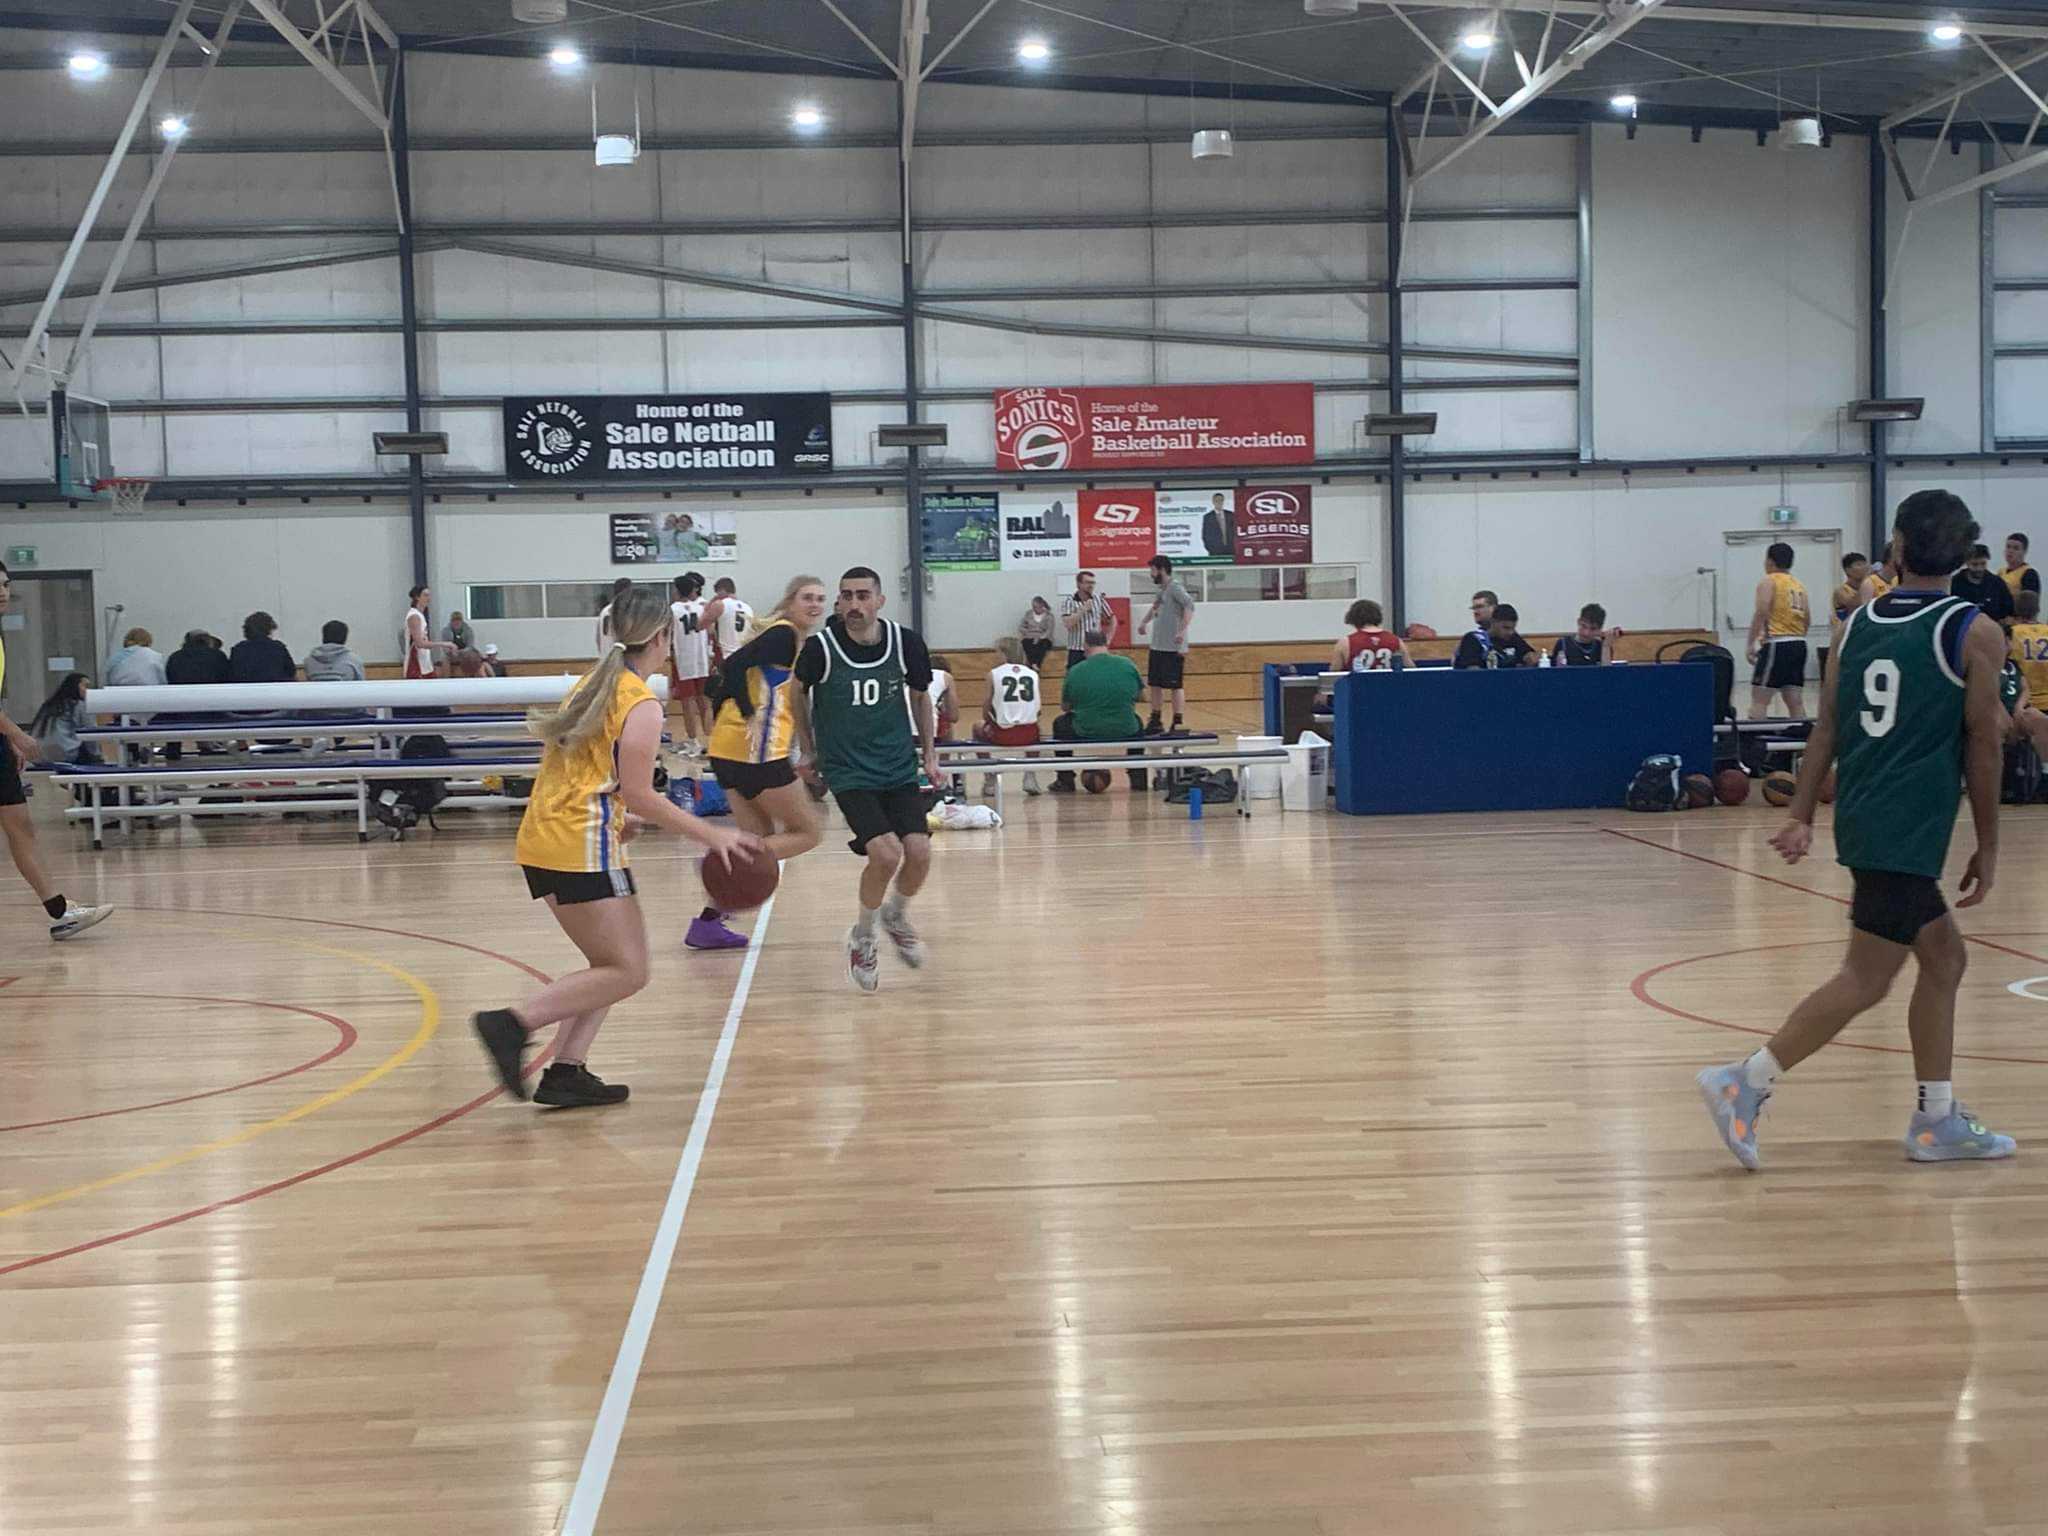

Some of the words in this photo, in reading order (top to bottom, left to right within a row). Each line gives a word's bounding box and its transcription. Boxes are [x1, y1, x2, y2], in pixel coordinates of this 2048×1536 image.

[636, 404, 688, 419] Home
[691, 403, 710, 418] of
[713, 402, 744, 417] the
[1091, 402, 1126, 413] Home
[1127, 402, 1140, 413] of
[1140, 401, 1159, 412] the
[516, 410, 538, 440] SALE
[536, 401, 587, 430] NETBALL
[998, 399, 1077, 442] SONICS
[1092, 416, 1132, 432] Sale
[1134, 415, 1219, 432] Amateur
[605, 422, 669, 445] Sale
[674, 420, 775, 444] Netball
[1092, 433, 1194, 451] Basketball
[1195, 431, 1307, 449] Association
[520, 439, 593, 475] ASSOCIATION
[607, 447, 776, 470] Association
[1254, 498, 1293, 515] SL
[1006, 516, 1046, 532] RAL
[1236, 524, 1311, 537] LEGENDS
[735, 610, 746, 633] 5
[2022, 637, 2048, 661] 12
[851, 678, 880, 706] 10
[1001, 675, 1035, 703] 23
[1859, 658, 1901, 738] 9
